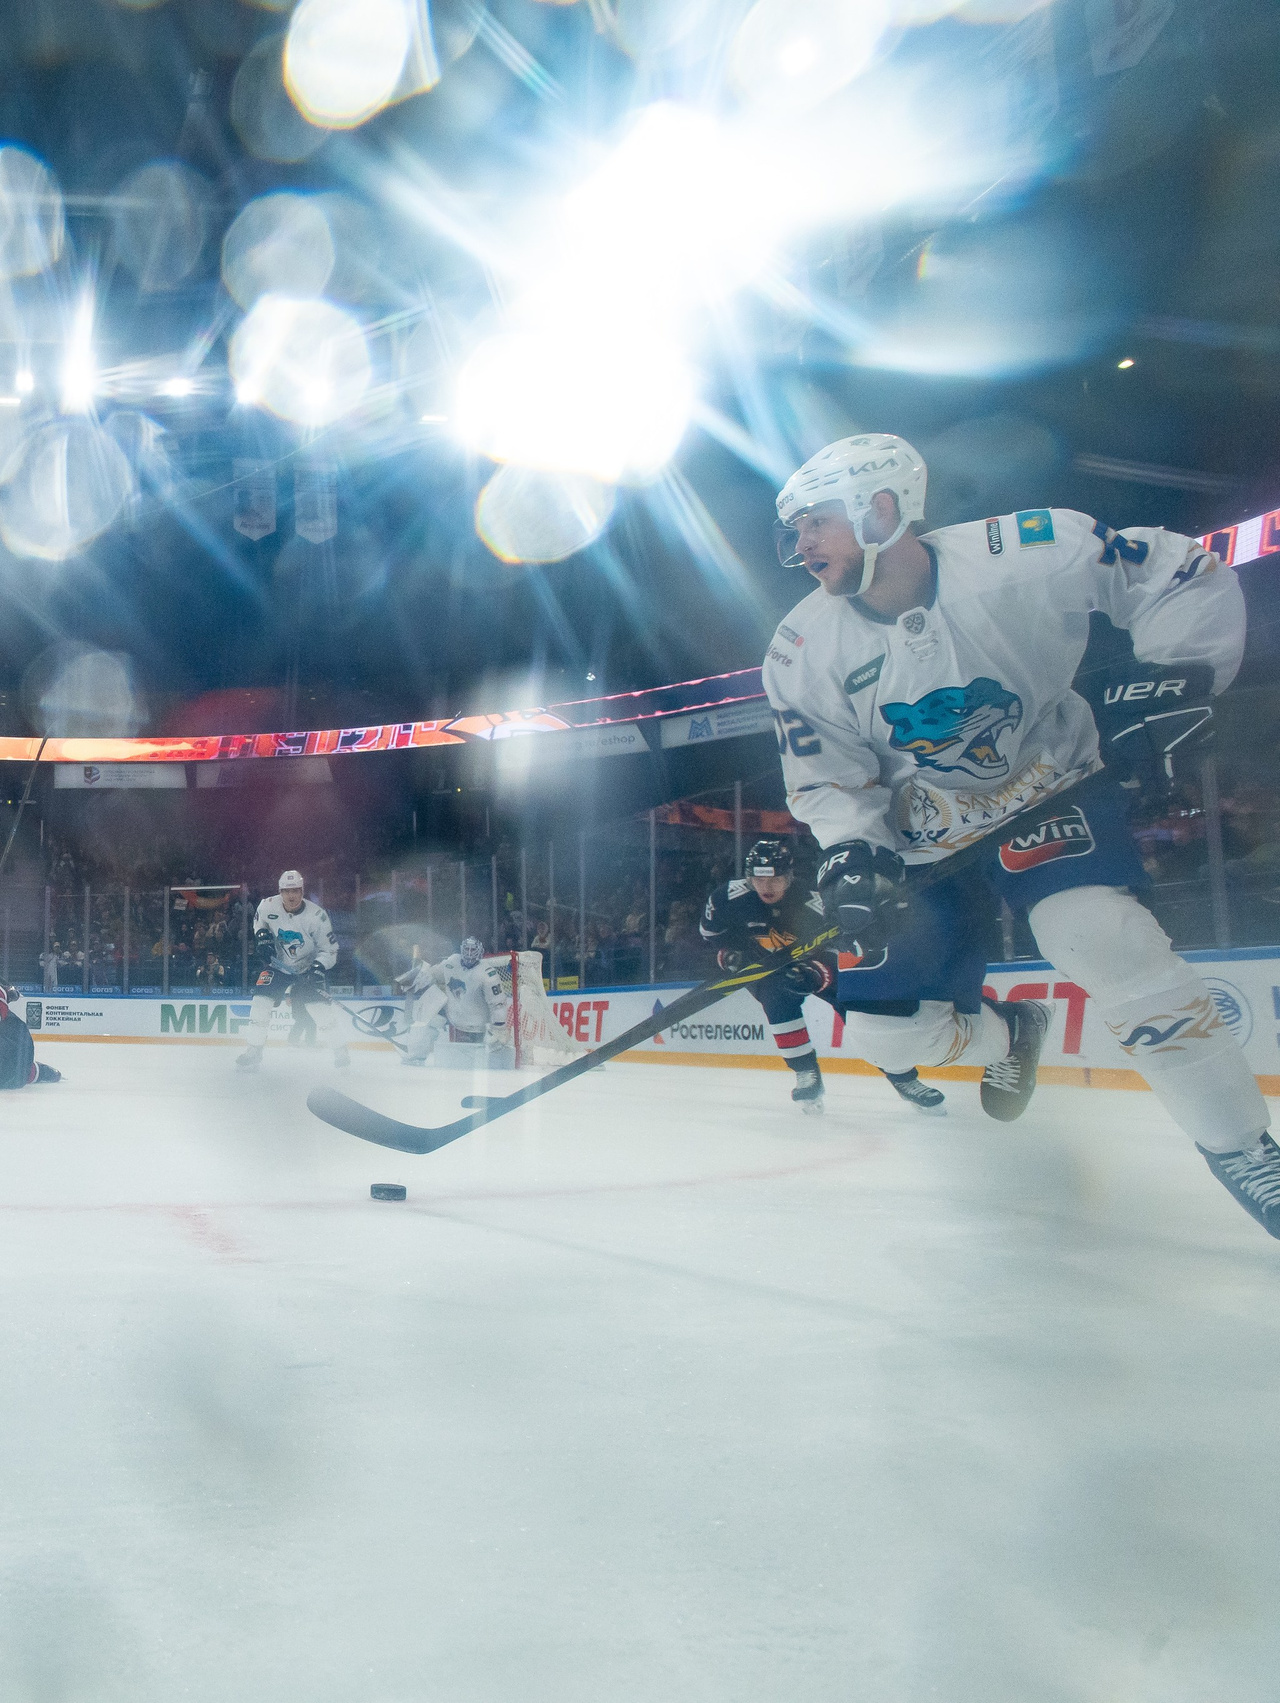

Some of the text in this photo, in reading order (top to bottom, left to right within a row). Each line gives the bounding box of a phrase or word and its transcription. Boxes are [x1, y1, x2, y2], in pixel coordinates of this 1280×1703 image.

[987, 521, 1001, 553] Winline
[852, 667, 878, 686] МИР
[955, 758, 1054, 813] SAMRUK
[791, 925, 840, 959] SUPE
[671, 1021, 765, 1041] Ростелеком
